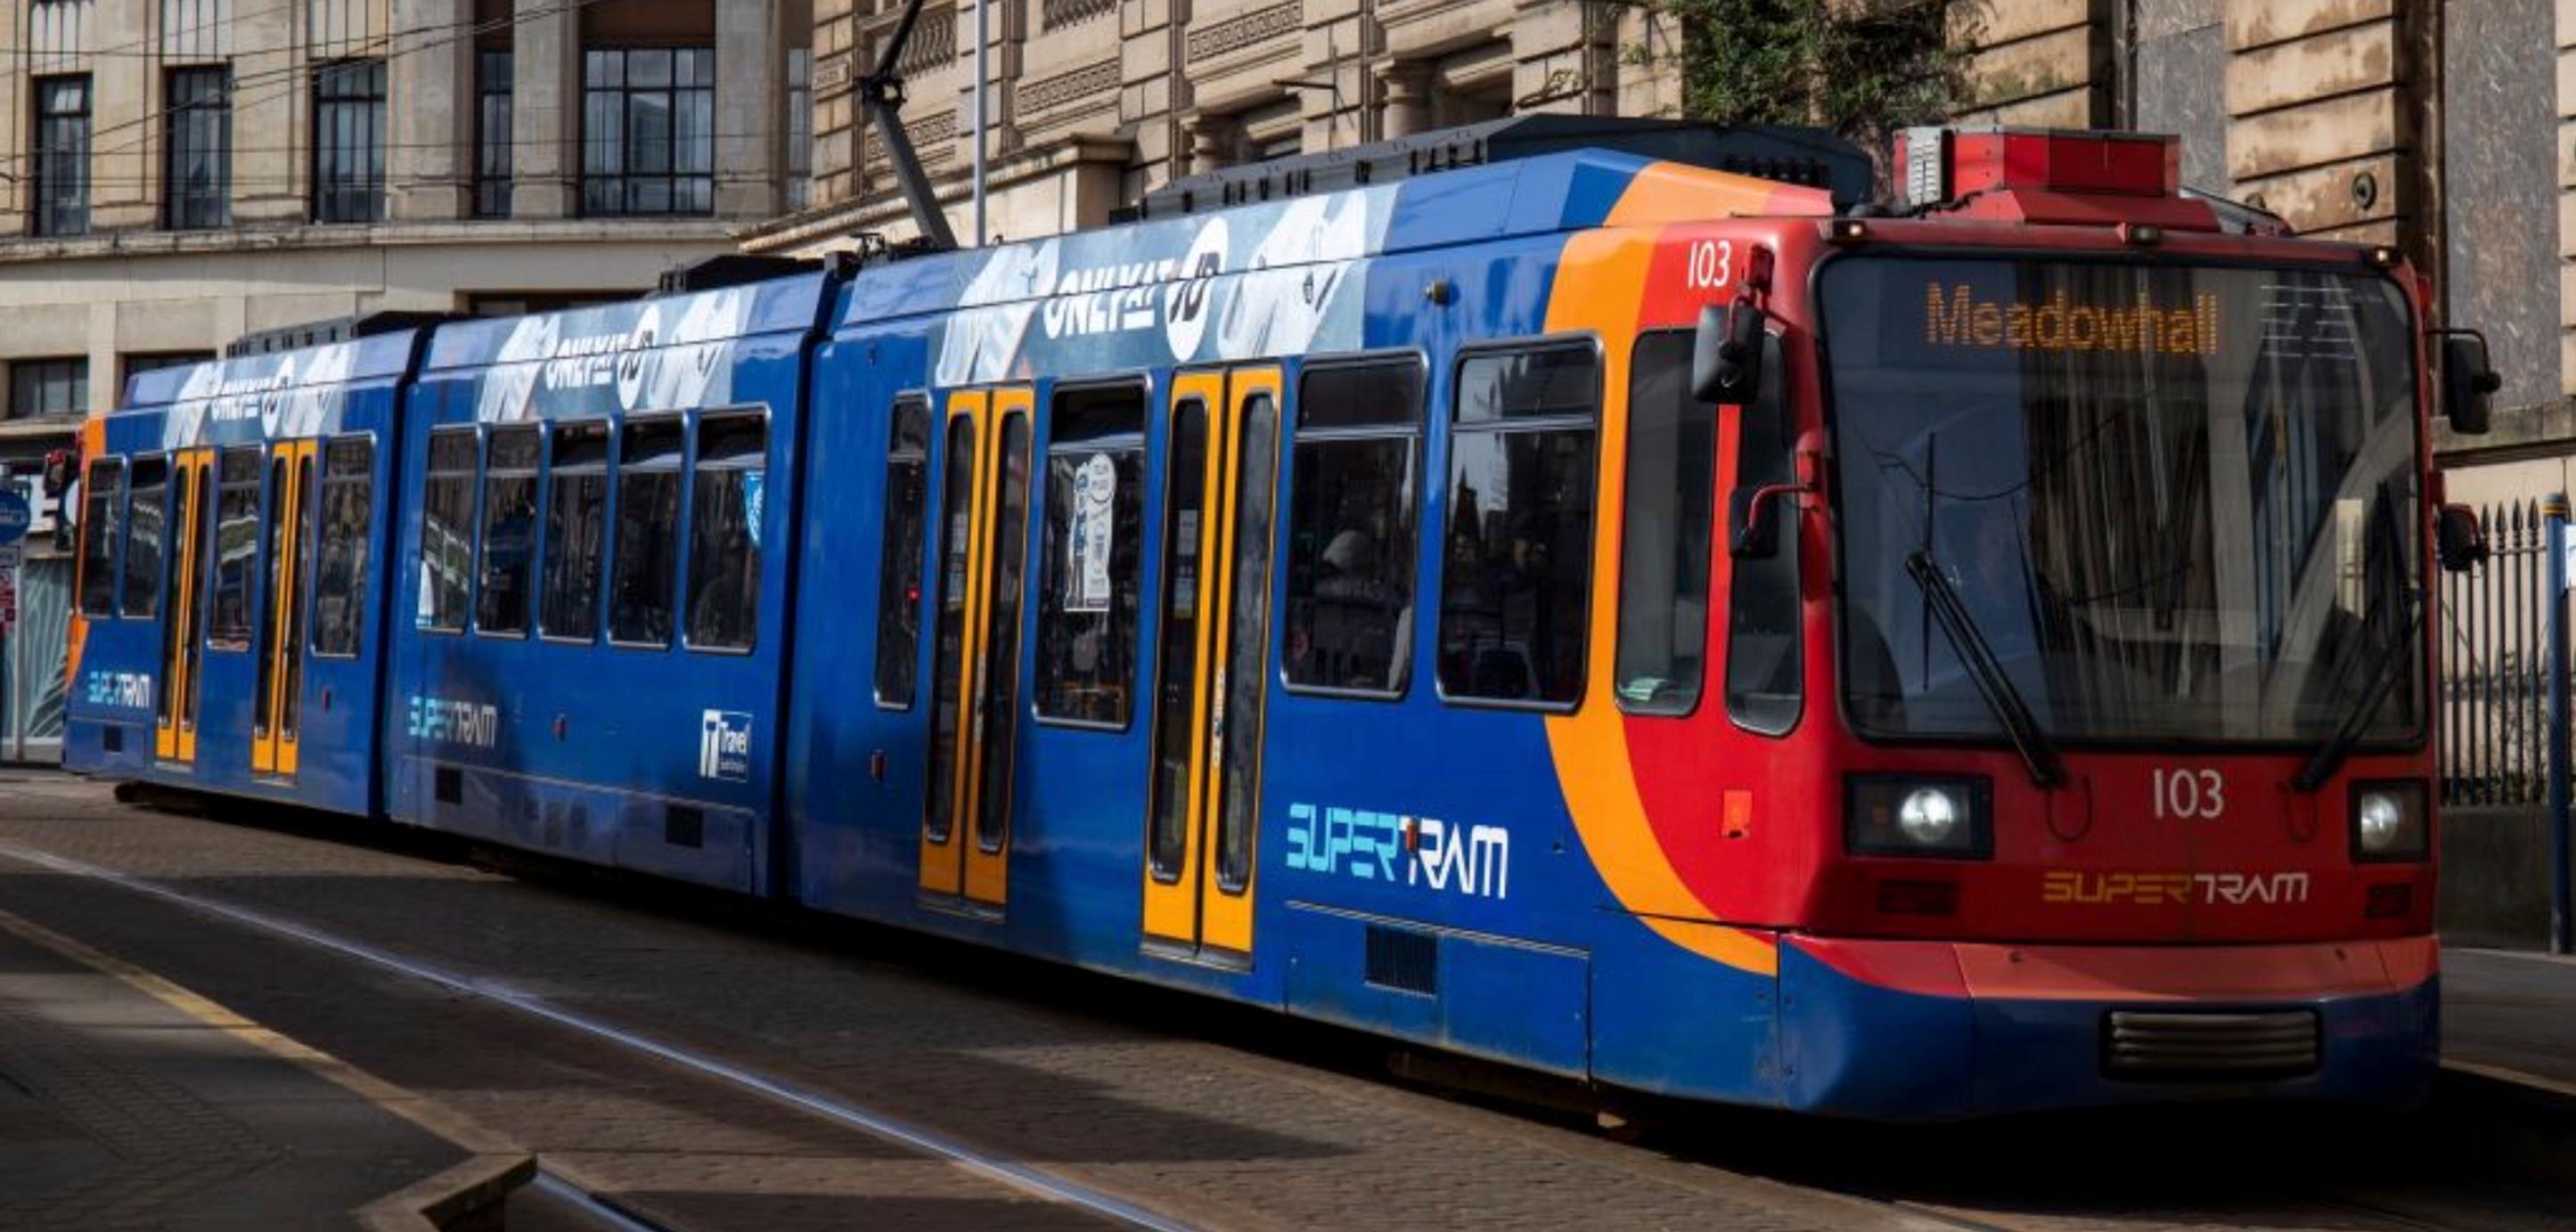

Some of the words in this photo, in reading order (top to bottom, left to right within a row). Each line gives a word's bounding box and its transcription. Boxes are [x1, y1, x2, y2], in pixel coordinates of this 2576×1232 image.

[1687, 240, 1730, 290] 103
[1926, 281, 2218, 355] Meadowhall
[409, 696, 496, 747] SUPERTRAM
[2153, 769, 2225, 819] 103
[1286, 803, 1508, 900] SUPERTRAM
[2042, 872, 2309, 904] SUPERTRAM
